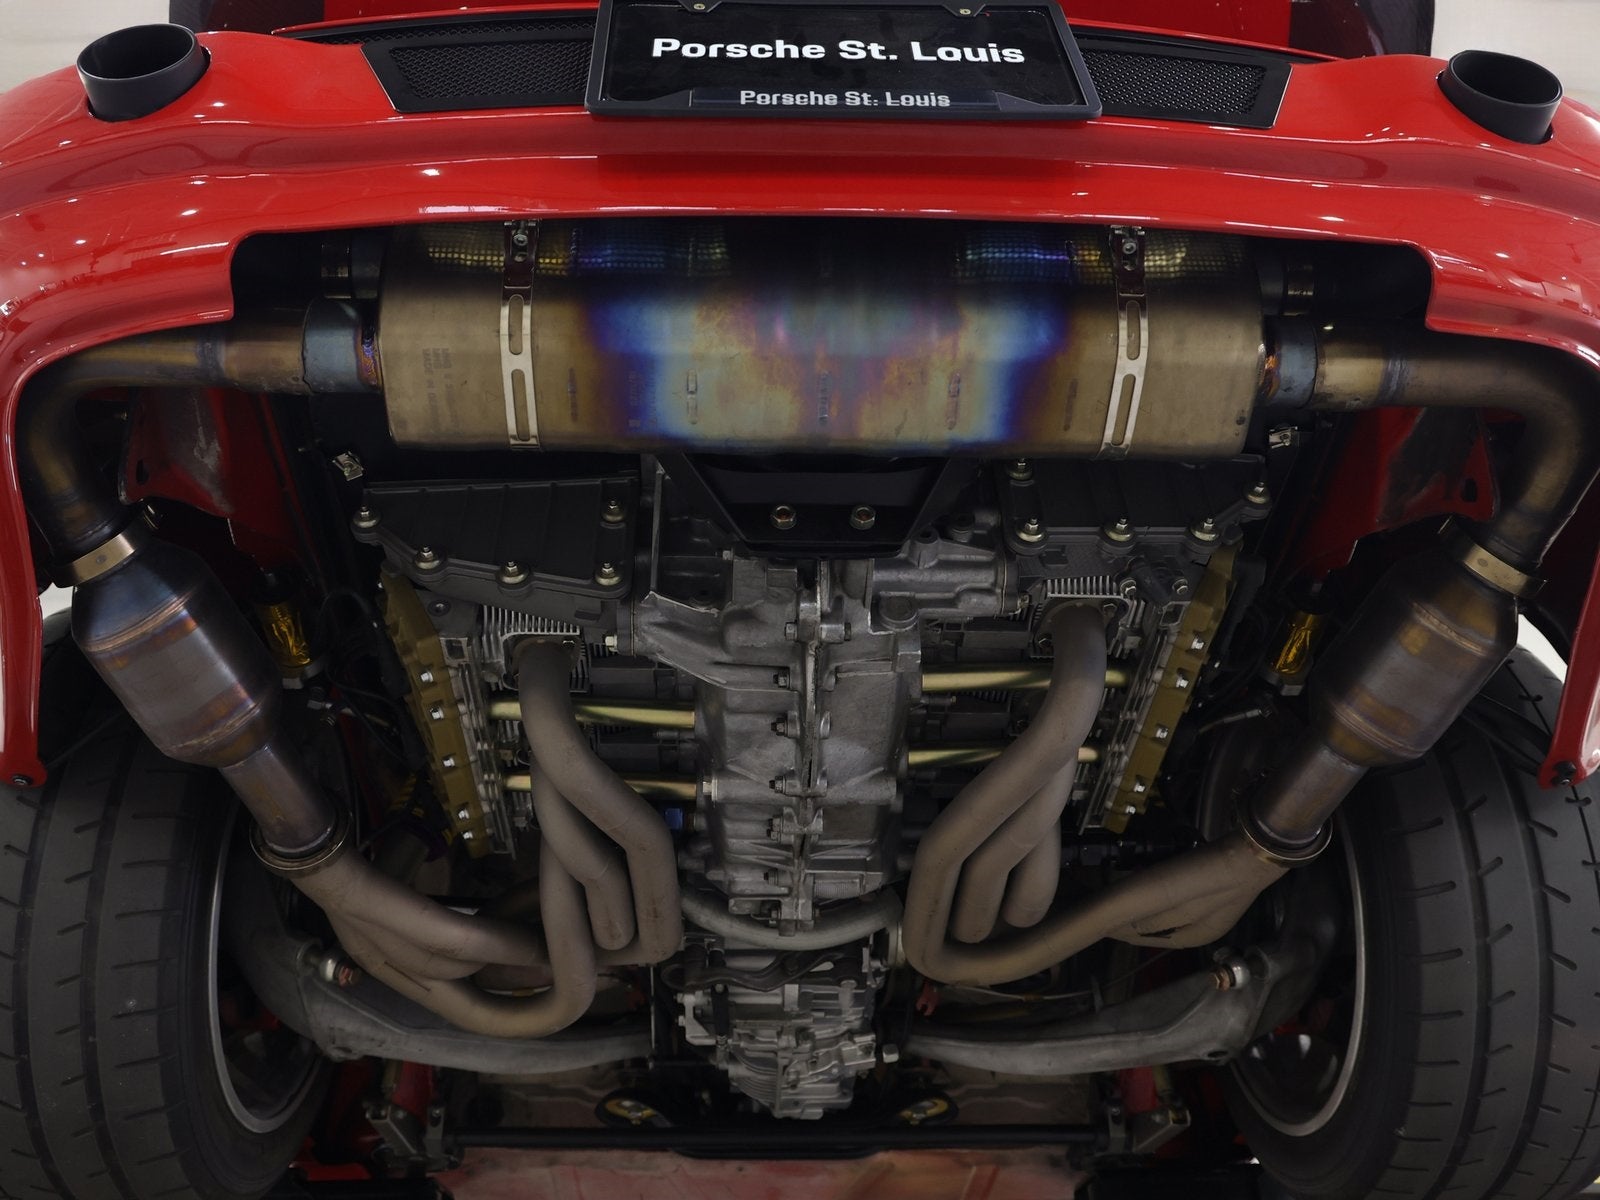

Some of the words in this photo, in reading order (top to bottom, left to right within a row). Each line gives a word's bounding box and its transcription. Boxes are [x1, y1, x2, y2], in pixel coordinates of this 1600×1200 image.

[652, 38, 826, 59] Porsche
[839, 39, 898, 60] St.
[910, 42, 1025, 63] Louis
[740, 90, 838, 106] Porsche
[845, 91, 879, 106] St.
[886, 92, 951, 107] Louis
